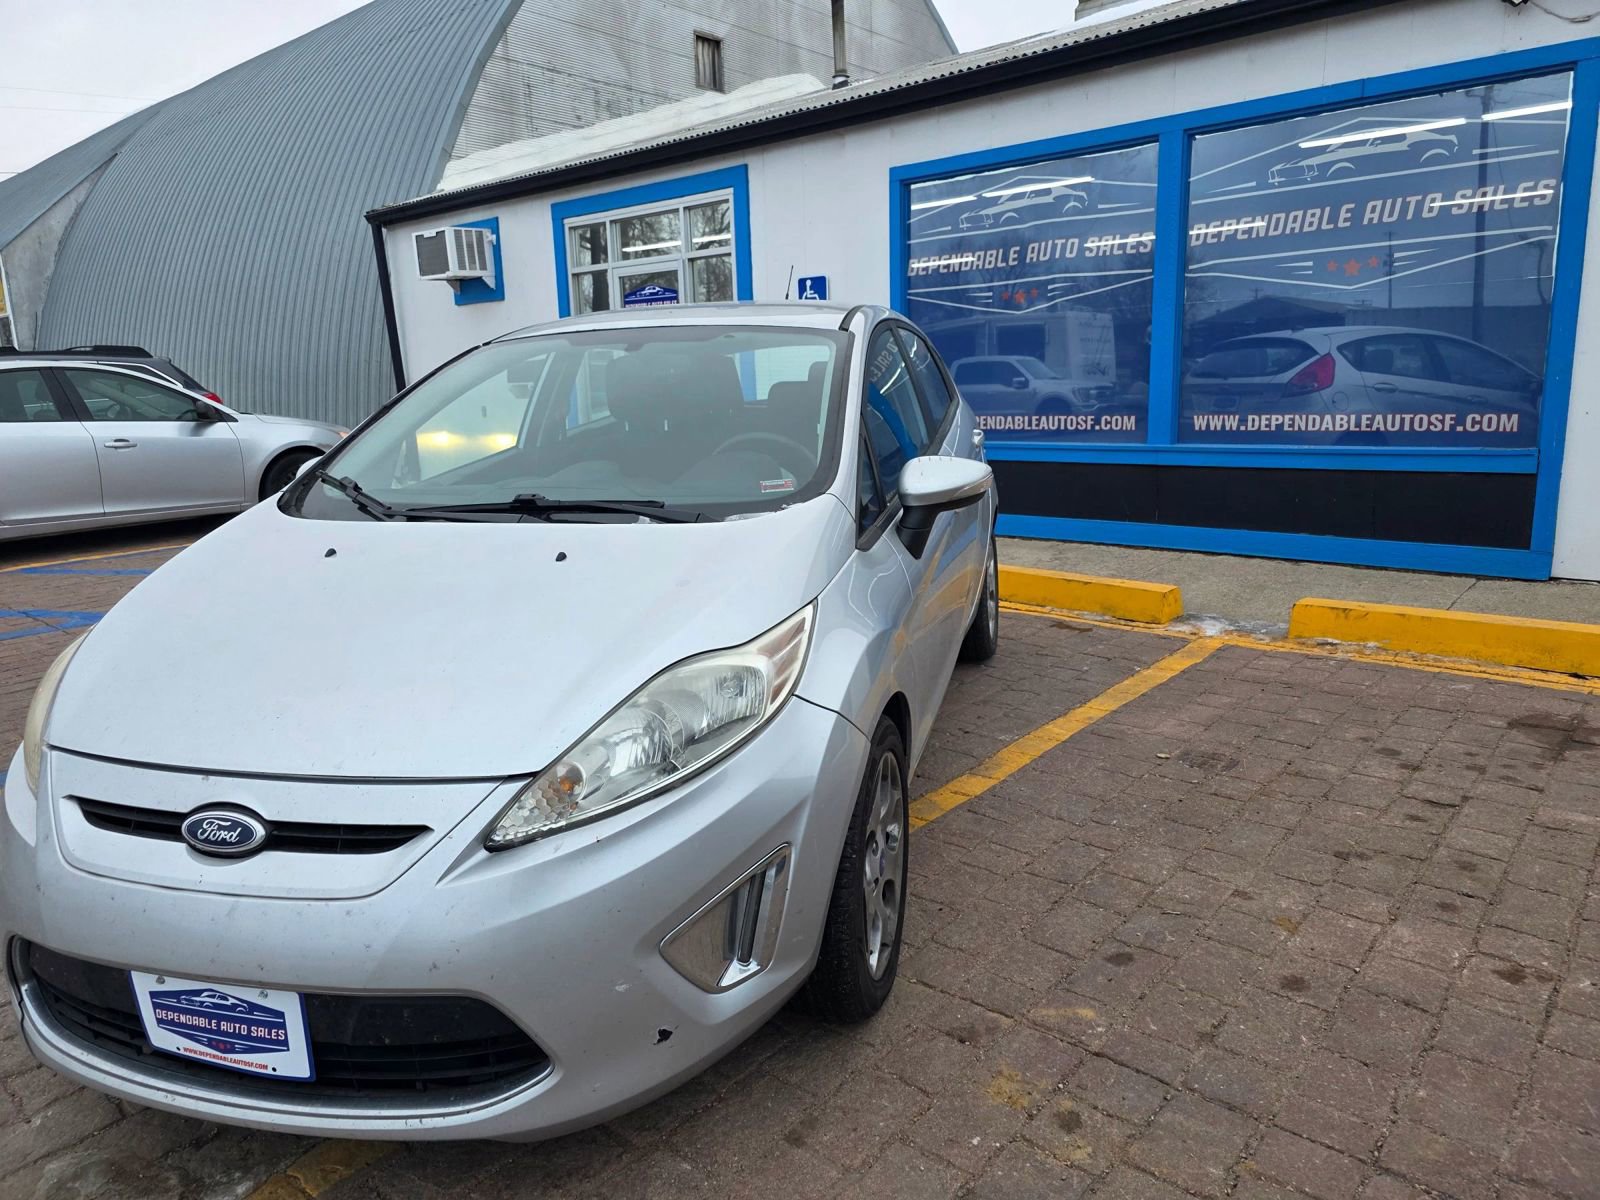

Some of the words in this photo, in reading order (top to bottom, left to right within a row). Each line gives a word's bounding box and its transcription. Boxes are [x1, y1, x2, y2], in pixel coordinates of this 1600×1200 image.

[1190, 203, 1355, 247] DEPENDABLE
[1362, 193, 1443, 225] AUTO
[1452, 179, 1556, 215] SALES
[907, 246, 1020, 276] DEPENDABLE
[1026, 238, 1079, 264] AUTO
[1085, 231, 1154, 257] SALES
[1193, 413, 1519, 432] WWW.DEPENDABLEAUTOSF.COM
[197, 819, 242, 843] Ford
[155, 1009, 218, 1030] DEPENDABLE
[220, 1020, 248, 1035] AUTO
[250, 1027, 286, 1041] SALES
[182, 1046, 269, 1071] WWW.DEPENDABLEAUTOSF.COM
